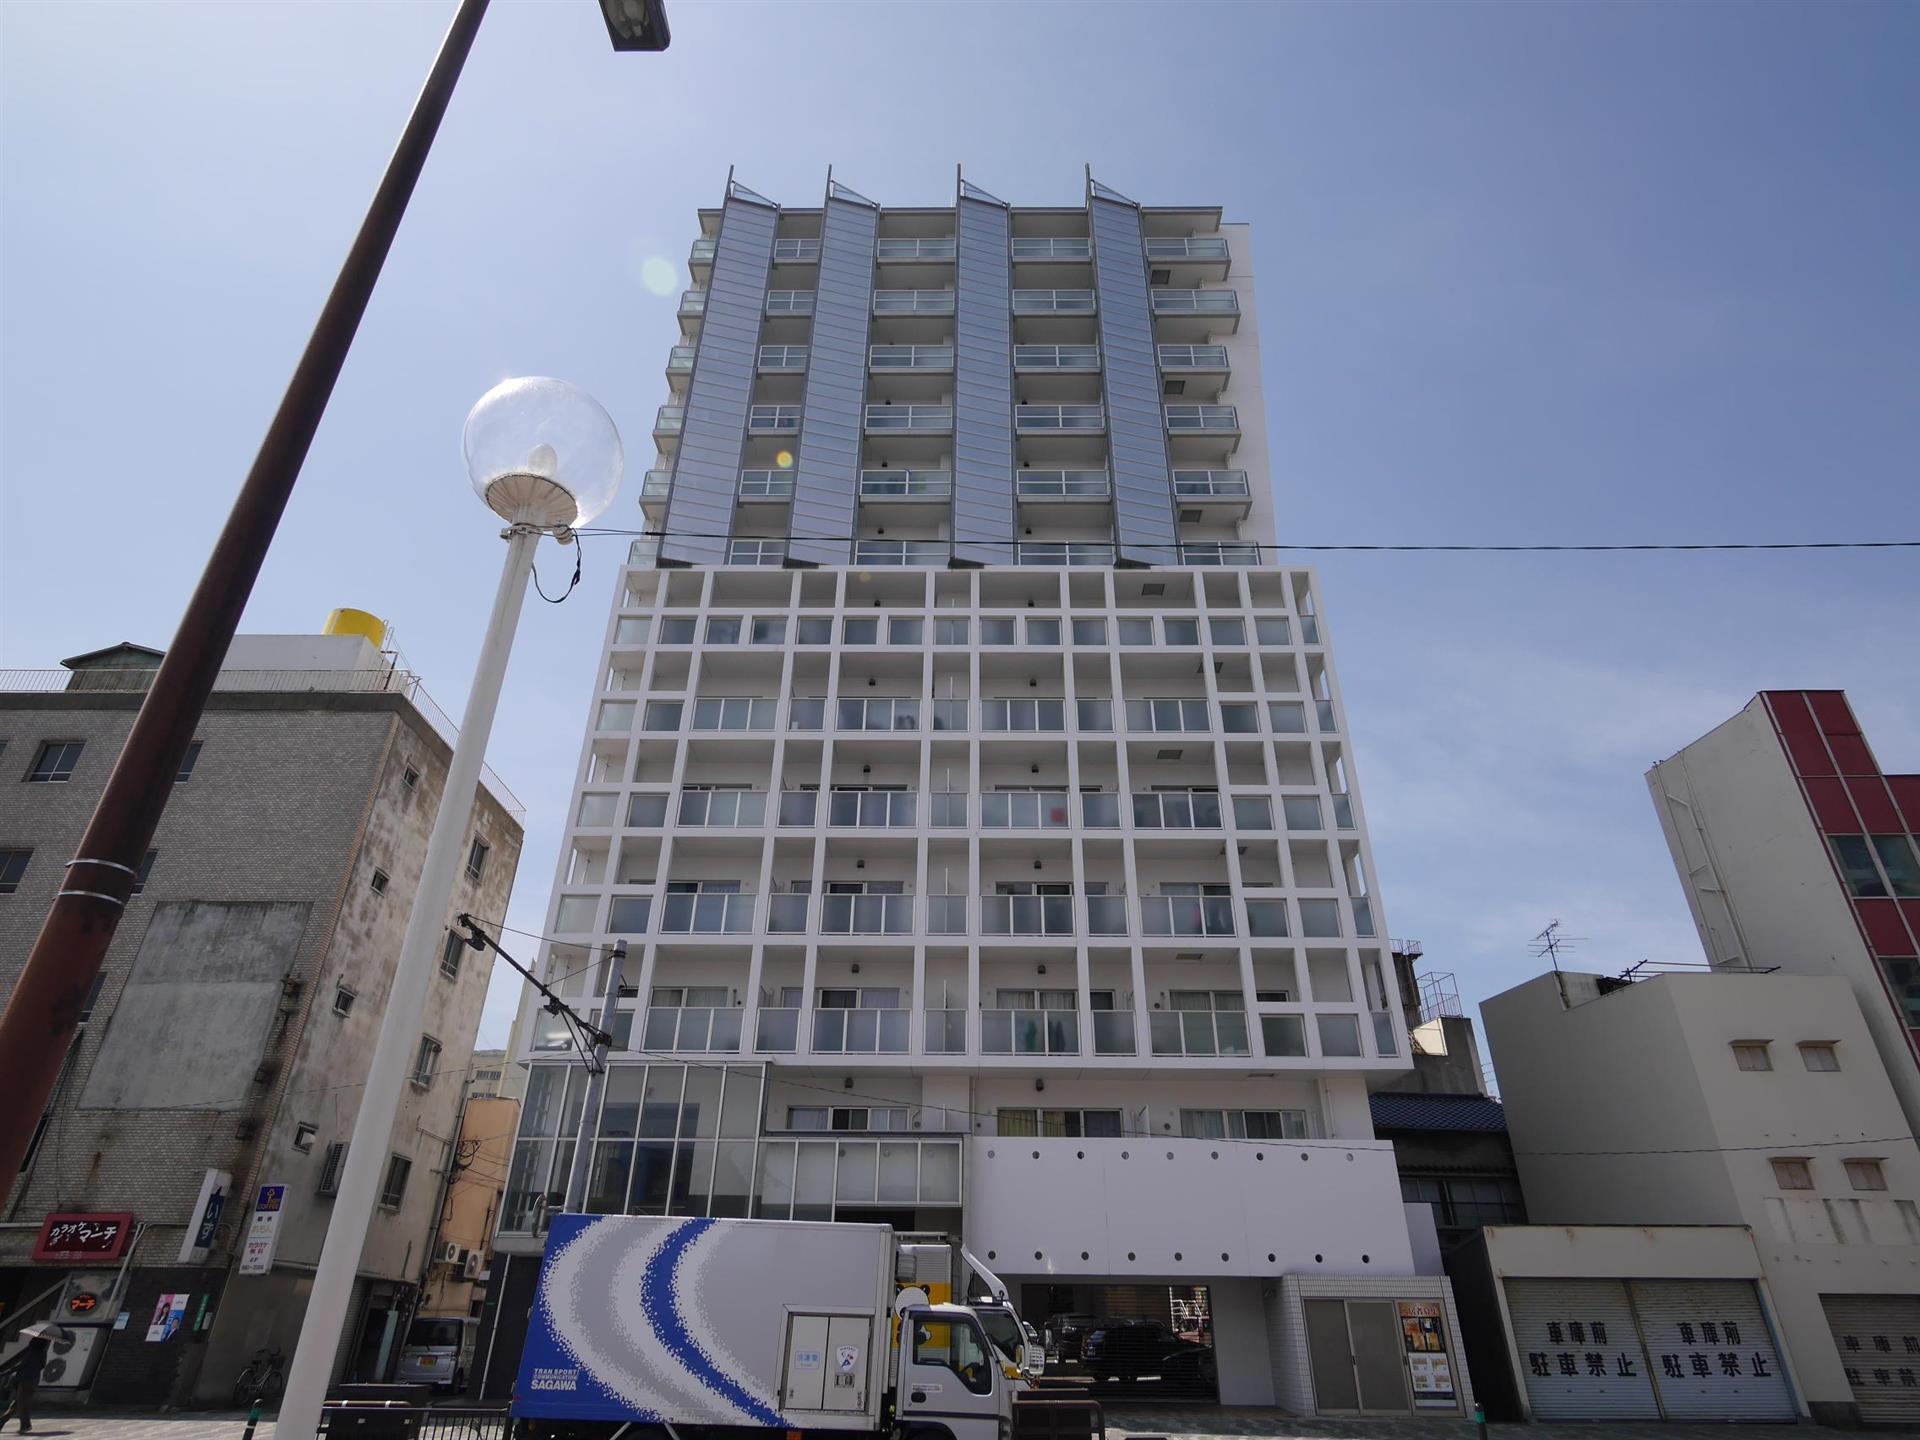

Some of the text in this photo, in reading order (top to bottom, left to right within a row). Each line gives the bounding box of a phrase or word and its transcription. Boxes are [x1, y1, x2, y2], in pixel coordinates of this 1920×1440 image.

[50, 1221, 117, 1242] カラオケ マーチ
[71, 1299, 96, 1310] マーチ
[1546, 1321, 1607, 1345] 車庫前
[1676, 1321, 1741, 1345] 車庫前
[1842, 1335, 1920, 1354] 車庫前
[1528, 1352, 1637, 1376] 駐車禁止
[1661, 1352, 1771, 1378] 駐車禁止
[530, 1379, 577, 1391] SAGAWA
